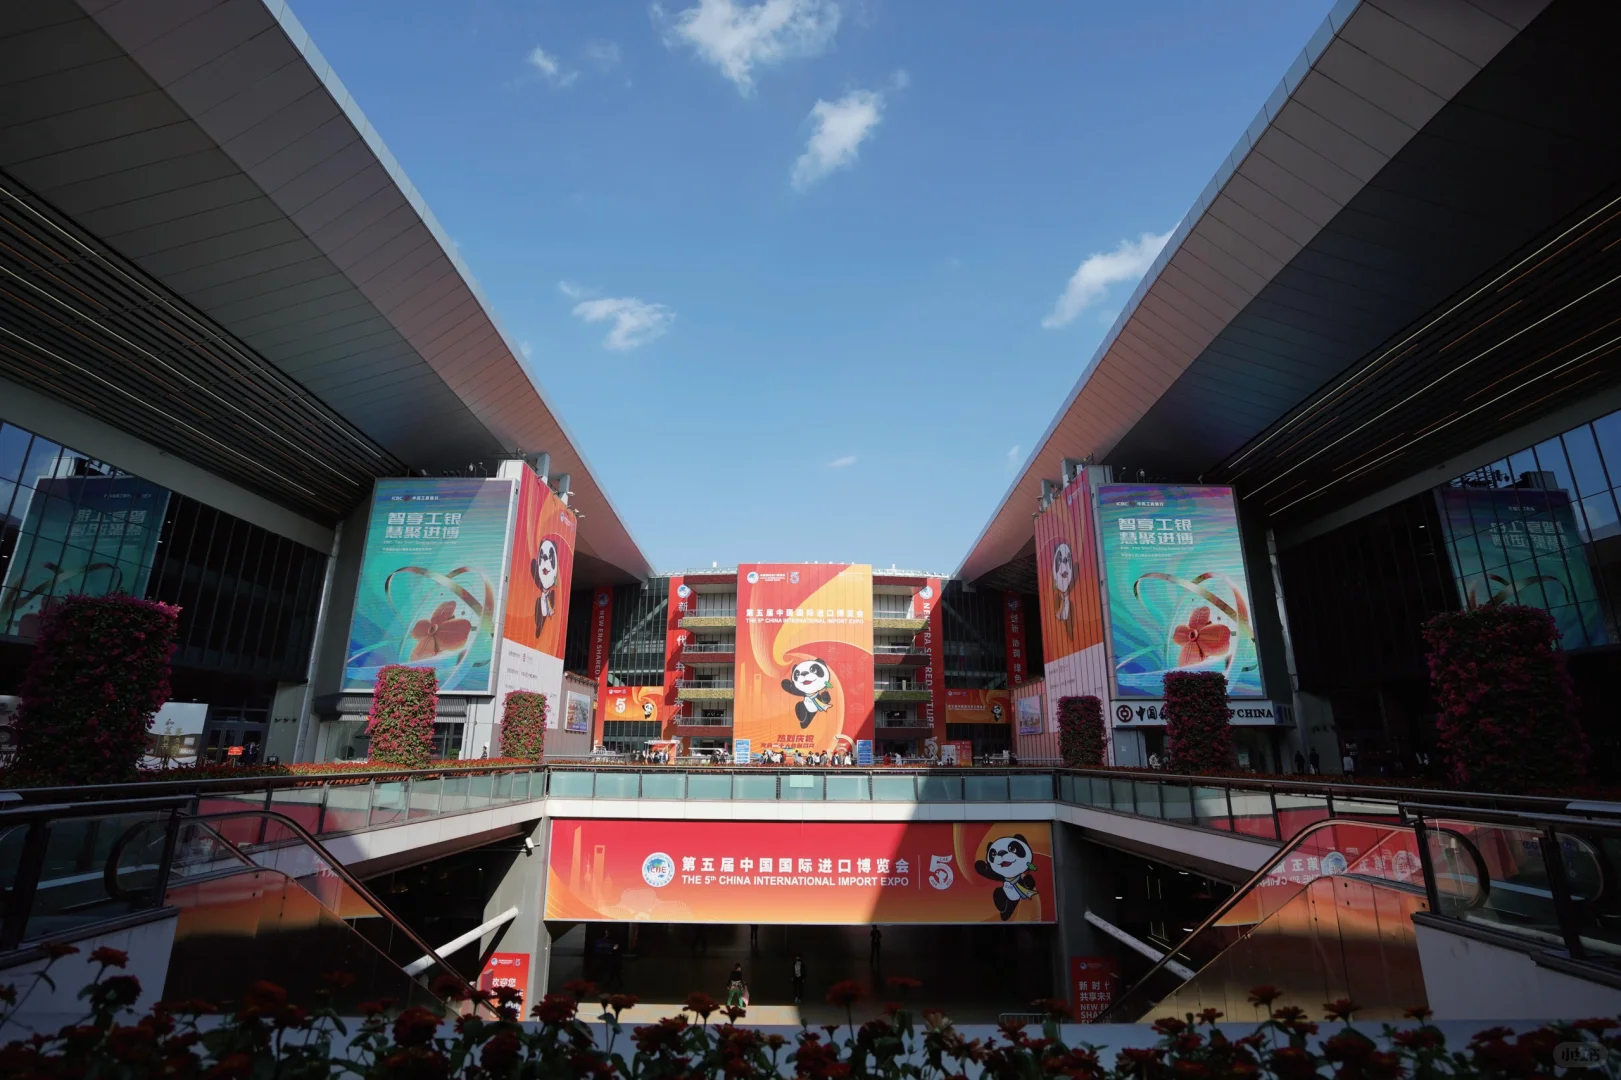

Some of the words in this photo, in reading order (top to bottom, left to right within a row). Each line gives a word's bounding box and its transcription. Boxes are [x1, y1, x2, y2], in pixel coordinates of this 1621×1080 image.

[387, 512, 462, 525] 智享工银
[1118, 518, 1192, 531] 智享工银
[385, 526, 460, 539] 慧聚进博
[1120, 531, 1194, 545] 慧聚进博
[746, 608, 864, 617] 第五届中国国际进口博览会
[595, 644, 603, 675] SHARED
[1237, 708, 1274, 718] CHINA
[777, 734, 814, 742] 热烈庆祝
[681, 856, 910, 874] 第五届中国国际进口博览会
[681, 875, 702, 884] THE
[704, 875, 716, 884] 5th
[718, 875, 751, 885] CHINA
[753, 876, 835, 886] INTERNATIONAL
[838, 876, 877, 886] IMPORT
[880, 877, 909, 886] EXPO
[1080, 1003, 1098, 1011] NEW
